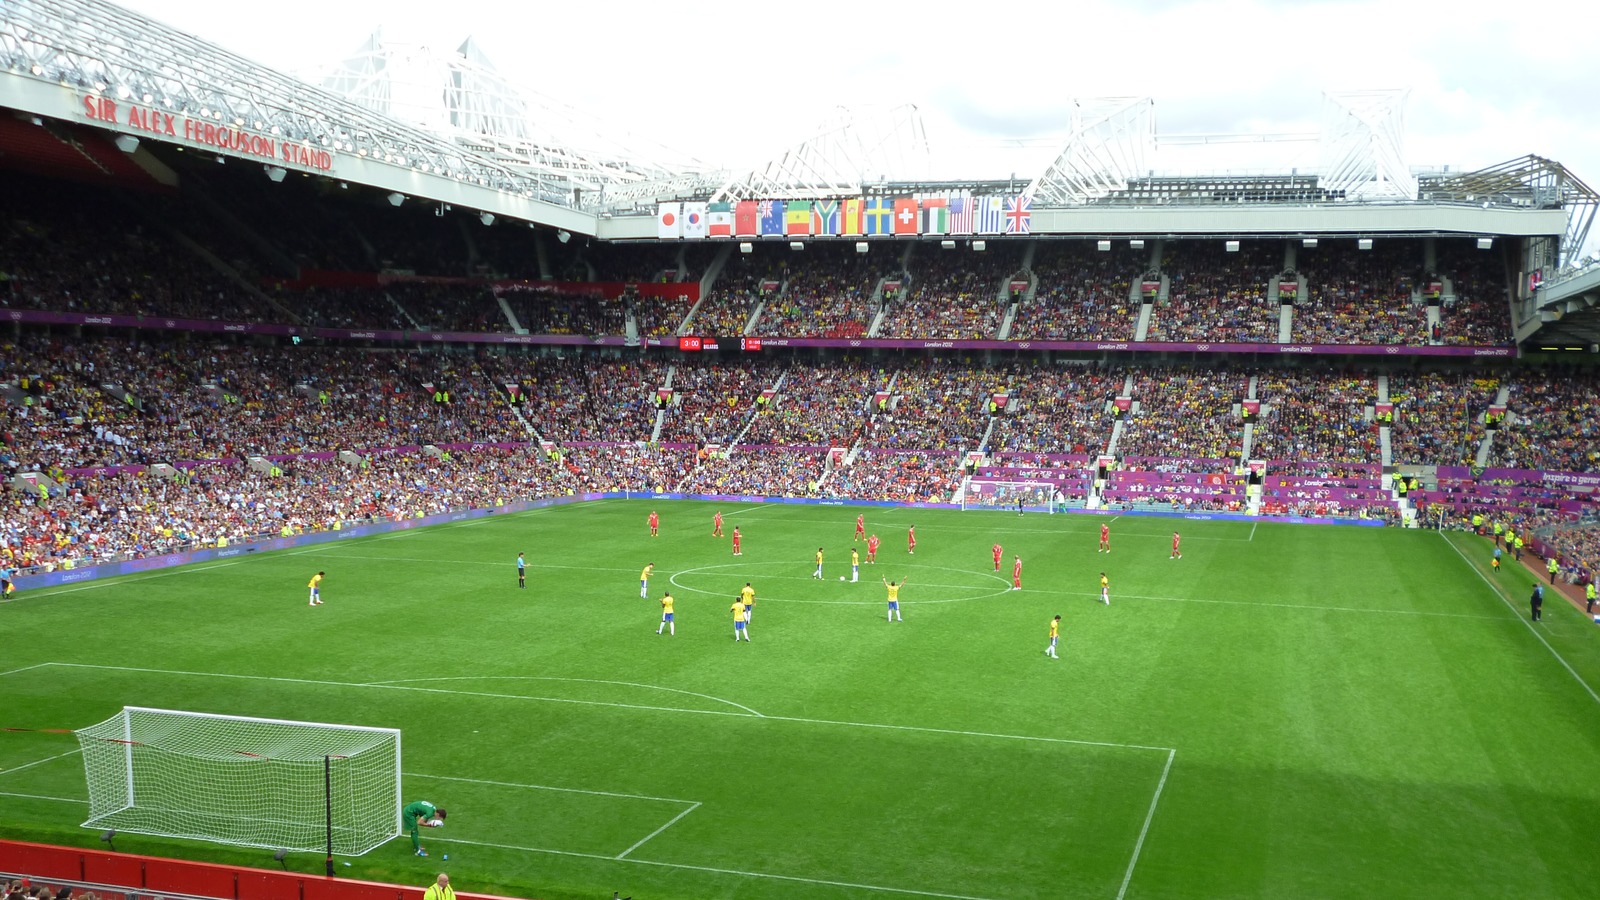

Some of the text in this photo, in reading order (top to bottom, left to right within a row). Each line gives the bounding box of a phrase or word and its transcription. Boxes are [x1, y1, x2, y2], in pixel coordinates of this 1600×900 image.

[84, 95, 332, 170] SIR ALEX FERGUSON STAND
[1543, 473, 1570, 484] Inspire
[1571, 475, 1577, 483] a
[62, 573, 79, 582] London
